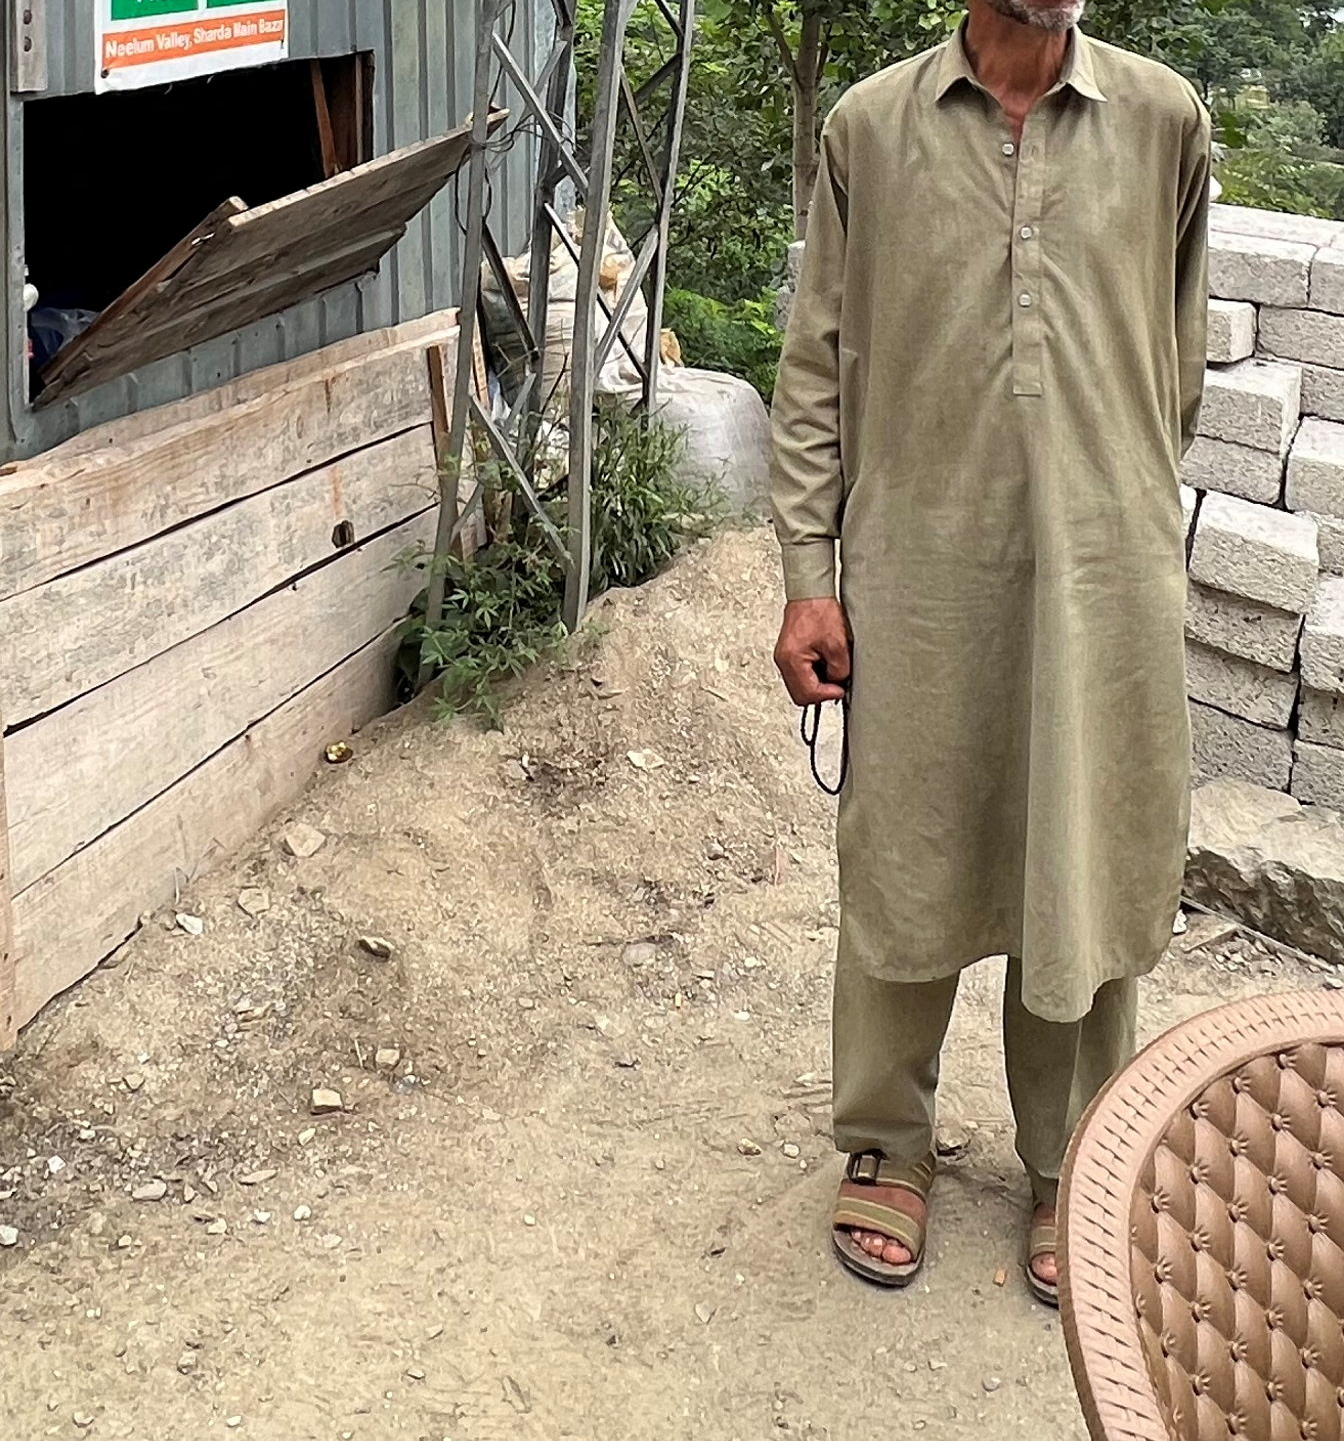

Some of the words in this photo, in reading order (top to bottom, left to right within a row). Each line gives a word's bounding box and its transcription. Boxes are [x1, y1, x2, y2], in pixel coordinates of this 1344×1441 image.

[106, 37, 155, 59] Neelum
[193, 26, 232, 45] Sharda
[233, 20, 257, 39] Main
